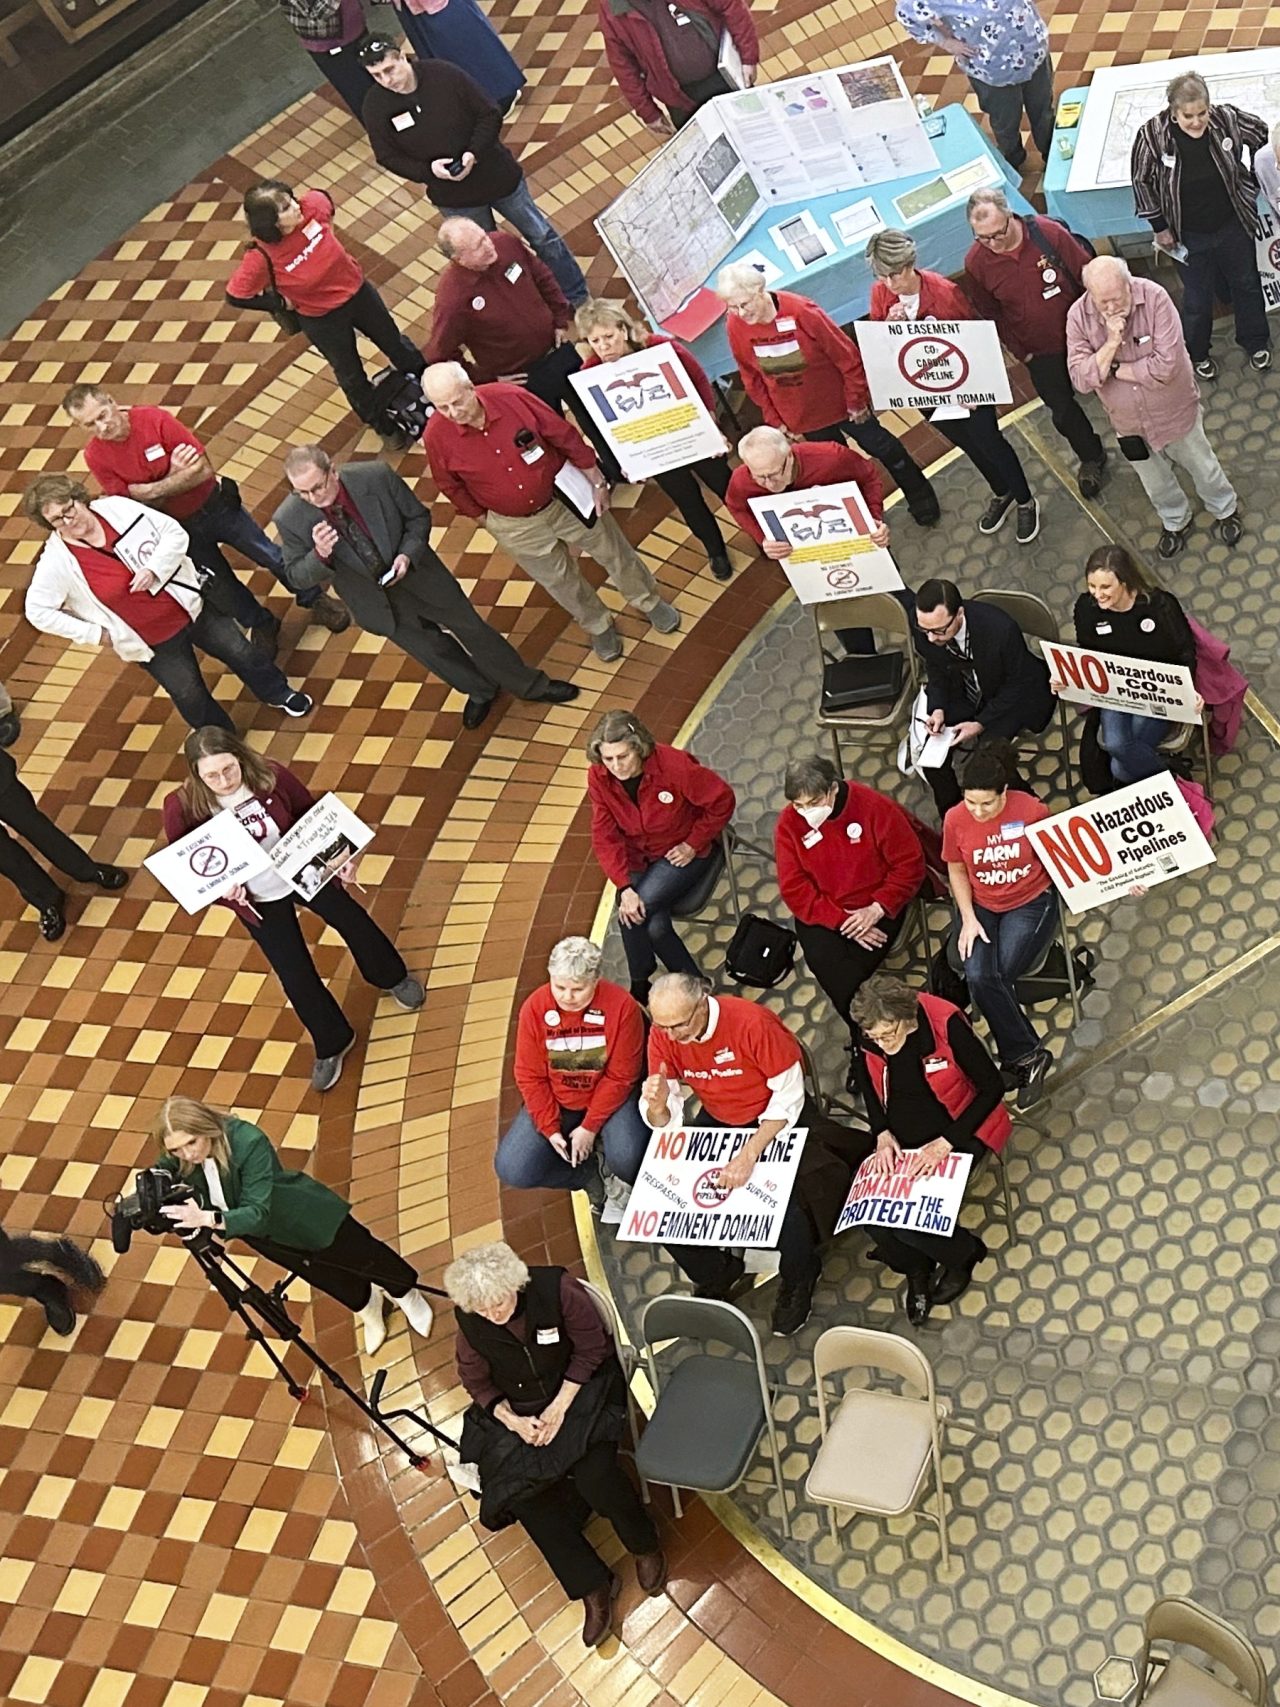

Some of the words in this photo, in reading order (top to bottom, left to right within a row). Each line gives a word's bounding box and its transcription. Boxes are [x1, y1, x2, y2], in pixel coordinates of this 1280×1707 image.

[888, 324, 903, 336] NO
[907, 323, 961, 335] EASEMENT
[889, 397, 904, 408] NO
[908, 395, 951, 407] EMINENT
[957, 393, 996, 404] DOMAIN
[1051, 648, 1110, 694] NO
[1104, 660, 1183, 686] Hazardous
[1116, 686, 1183, 706] Pipelines
[1125, 679, 1166, 694] CO2
[987, 834, 1003, 846] MY
[1036, 815, 1113, 889] NO
[1091, 790, 1174, 833] Hazardous
[1121, 820, 1165, 844] CO2
[972, 842, 1021, 865] FARM
[1117, 830, 1187, 865] Pipelines
[975, 863, 1032, 886] CHOICE
[654, 1131, 687, 1160] NO
[685, 1131, 731, 1162] WOLF
[728, 1133, 798, 1162] PILINE
[641, 1171, 688, 1210] TRESPASSING
[666, 1173, 681, 1186] NO
[764, 1179, 778, 1192] NO
[847, 1175, 915, 1206] DOMAIN
[746, 1182, 778, 1208] SURVEYS
[920, 1195, 944, 1214] THE
[837, 1198, 917, 1230] PROTECT
[915, 1211, 952, 1232] LAND
[627, 1210, 659, 1237] NO
[656, 1211, 721, 1239] EMINENT
[719, 1213, 775, 1242] DOMAIN
